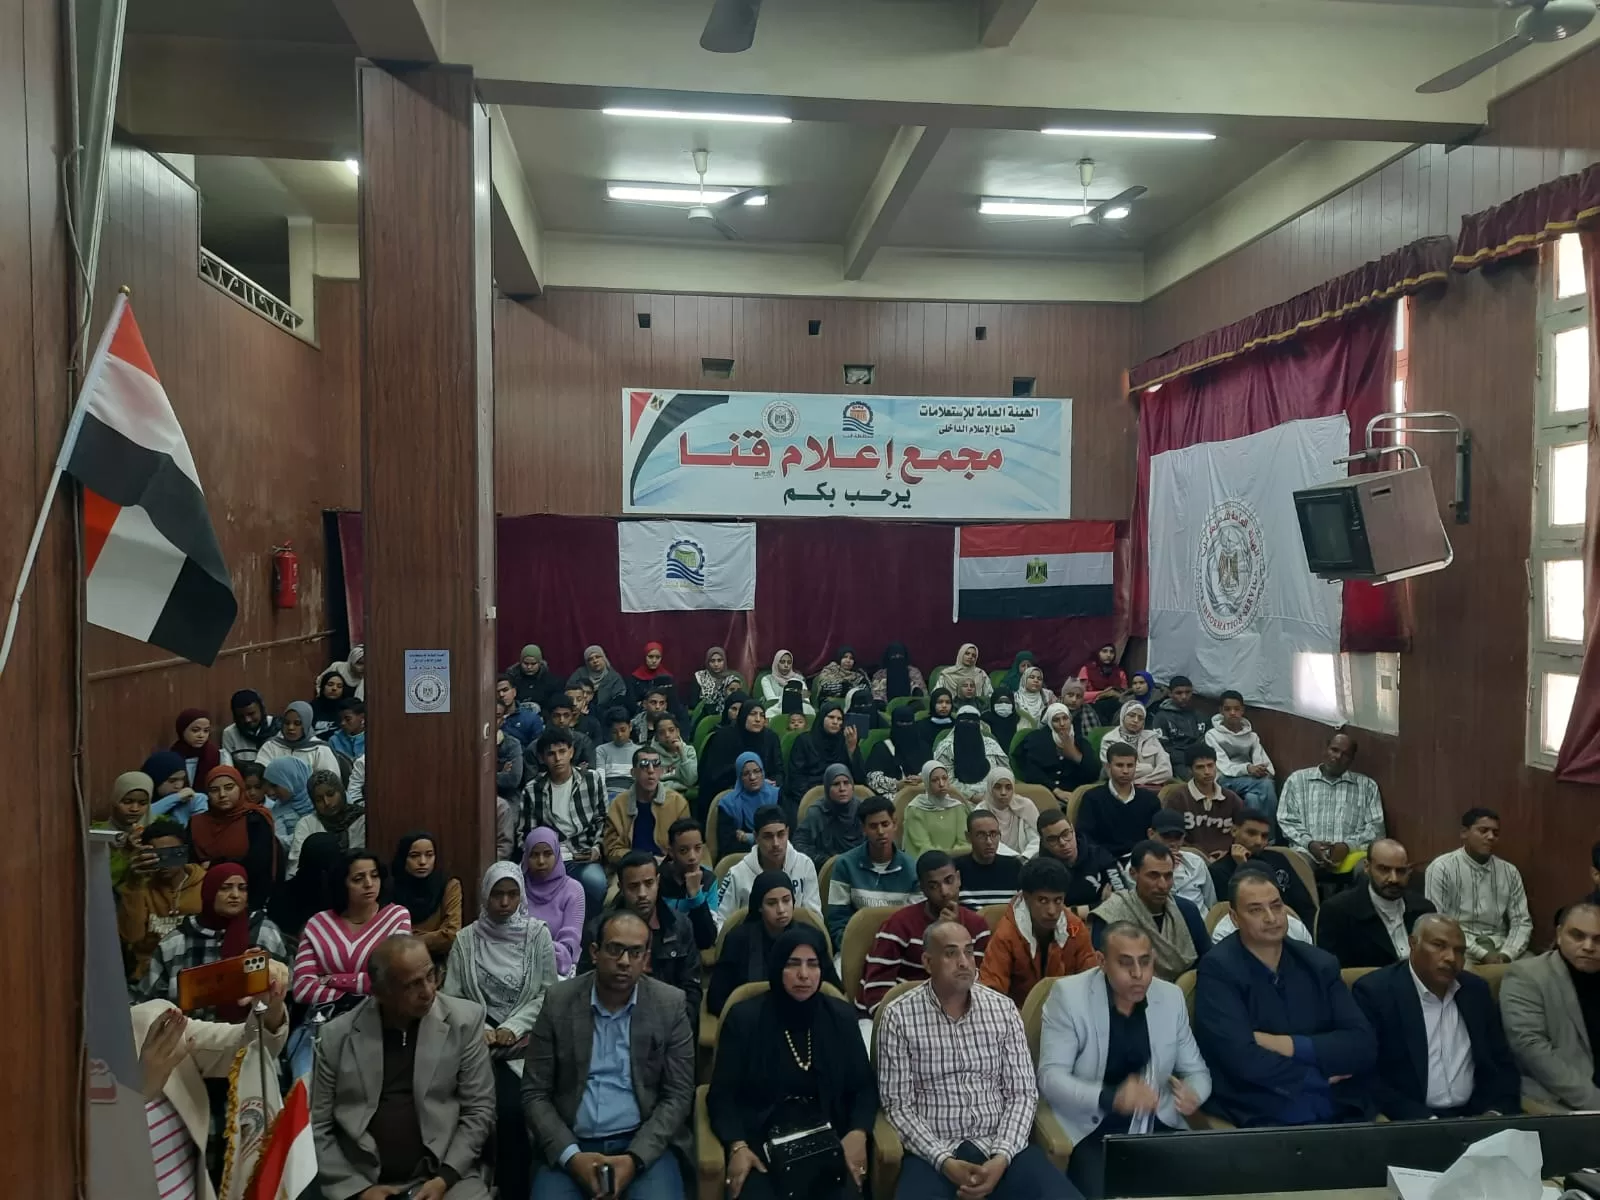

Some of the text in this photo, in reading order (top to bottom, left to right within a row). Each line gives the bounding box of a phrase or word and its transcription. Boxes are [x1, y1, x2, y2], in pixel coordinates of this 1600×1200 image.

[976, 405, 1006, 417] العامة
[994, 423, 1016, 436] قطاع
[679, 429, 1003, 484] مجمع إعلام قنا
[783, 481, 912, 509] يرحب بكم
[1202, 602, 1243, 631] INFORMATION
